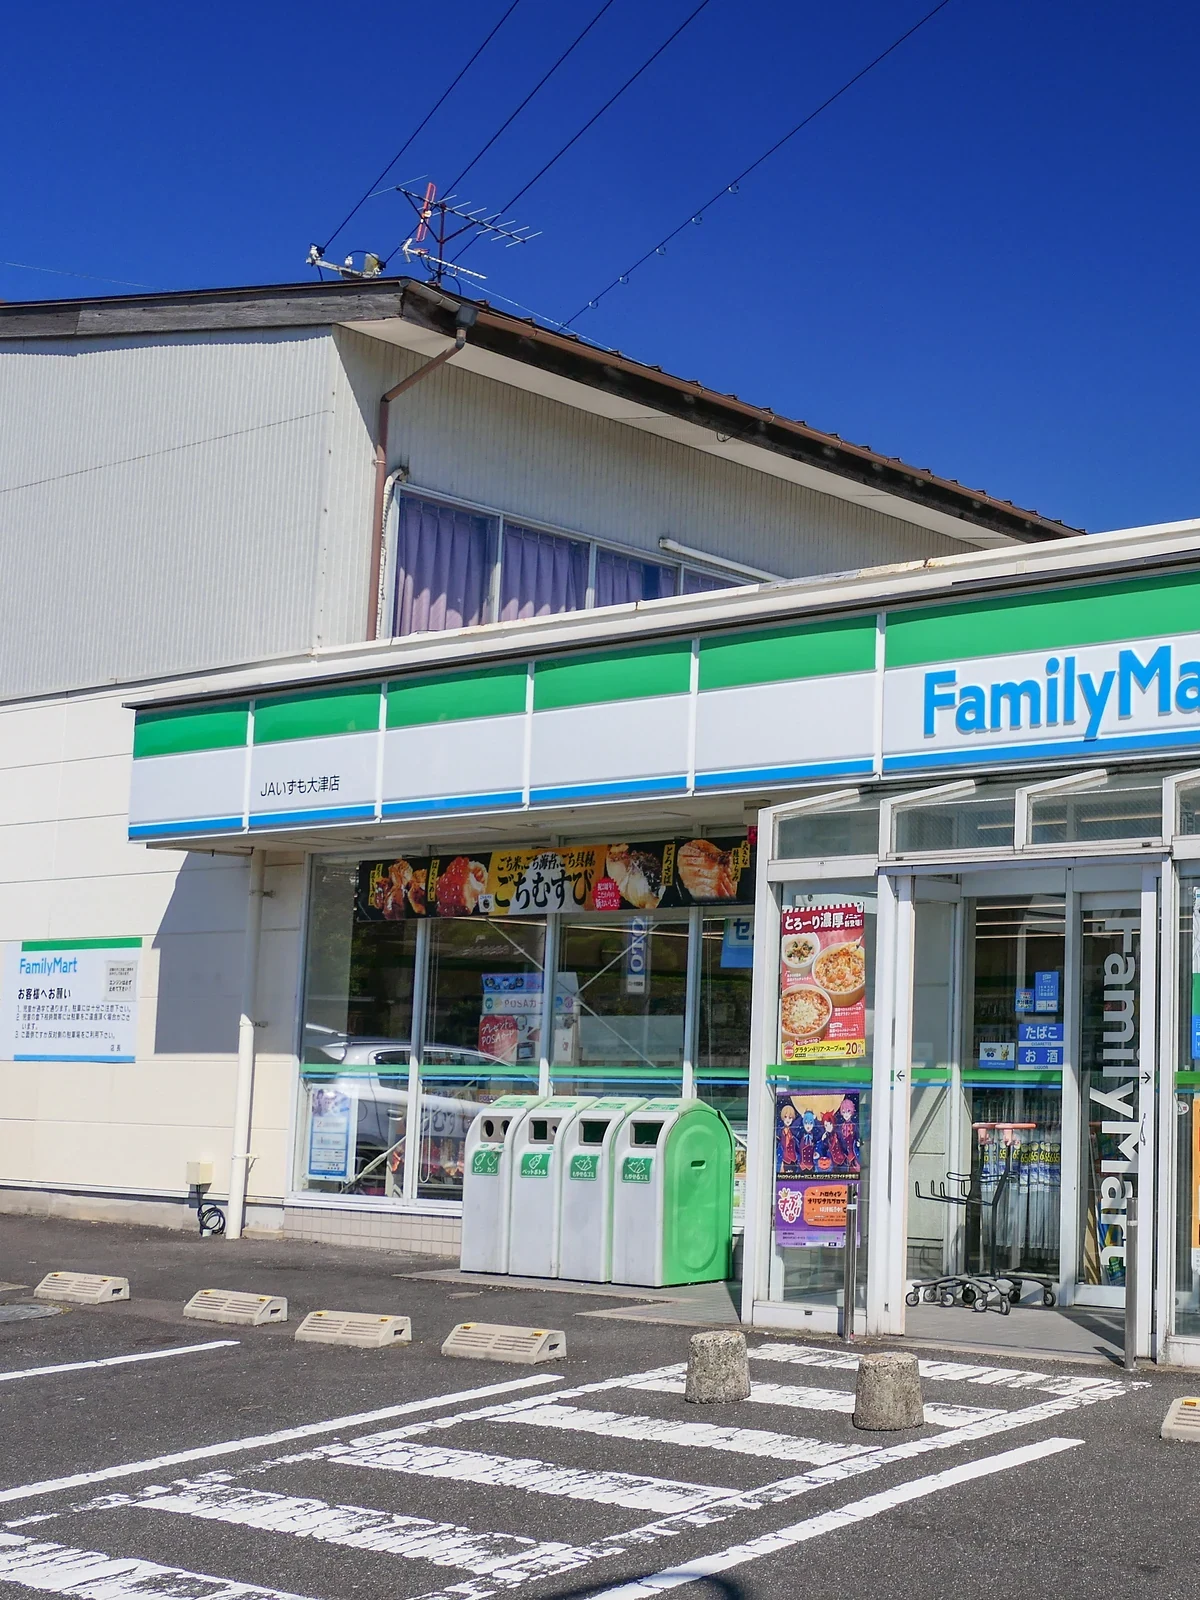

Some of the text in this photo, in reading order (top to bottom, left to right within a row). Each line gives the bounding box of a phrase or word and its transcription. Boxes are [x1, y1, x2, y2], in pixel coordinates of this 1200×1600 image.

[260, 774, 340, 797] JAいずも大津店
[663, 846, 674, 885] とろさば
[495, 869, 594, 909] ごちむすび
[733, 917, 754, 941] セ
[19, 957, 78, 976] FamilyMart
[18, 987, 71, 1000] お客様へお願い
[1025, 1026, 1058, 1039] たばこ
[795, 1045, 839, 1053] グラタン・ドリア・スープ
[845, 1042, 858, 1055] 20
[1089, 918, 1141, 1266] FamilyMart
